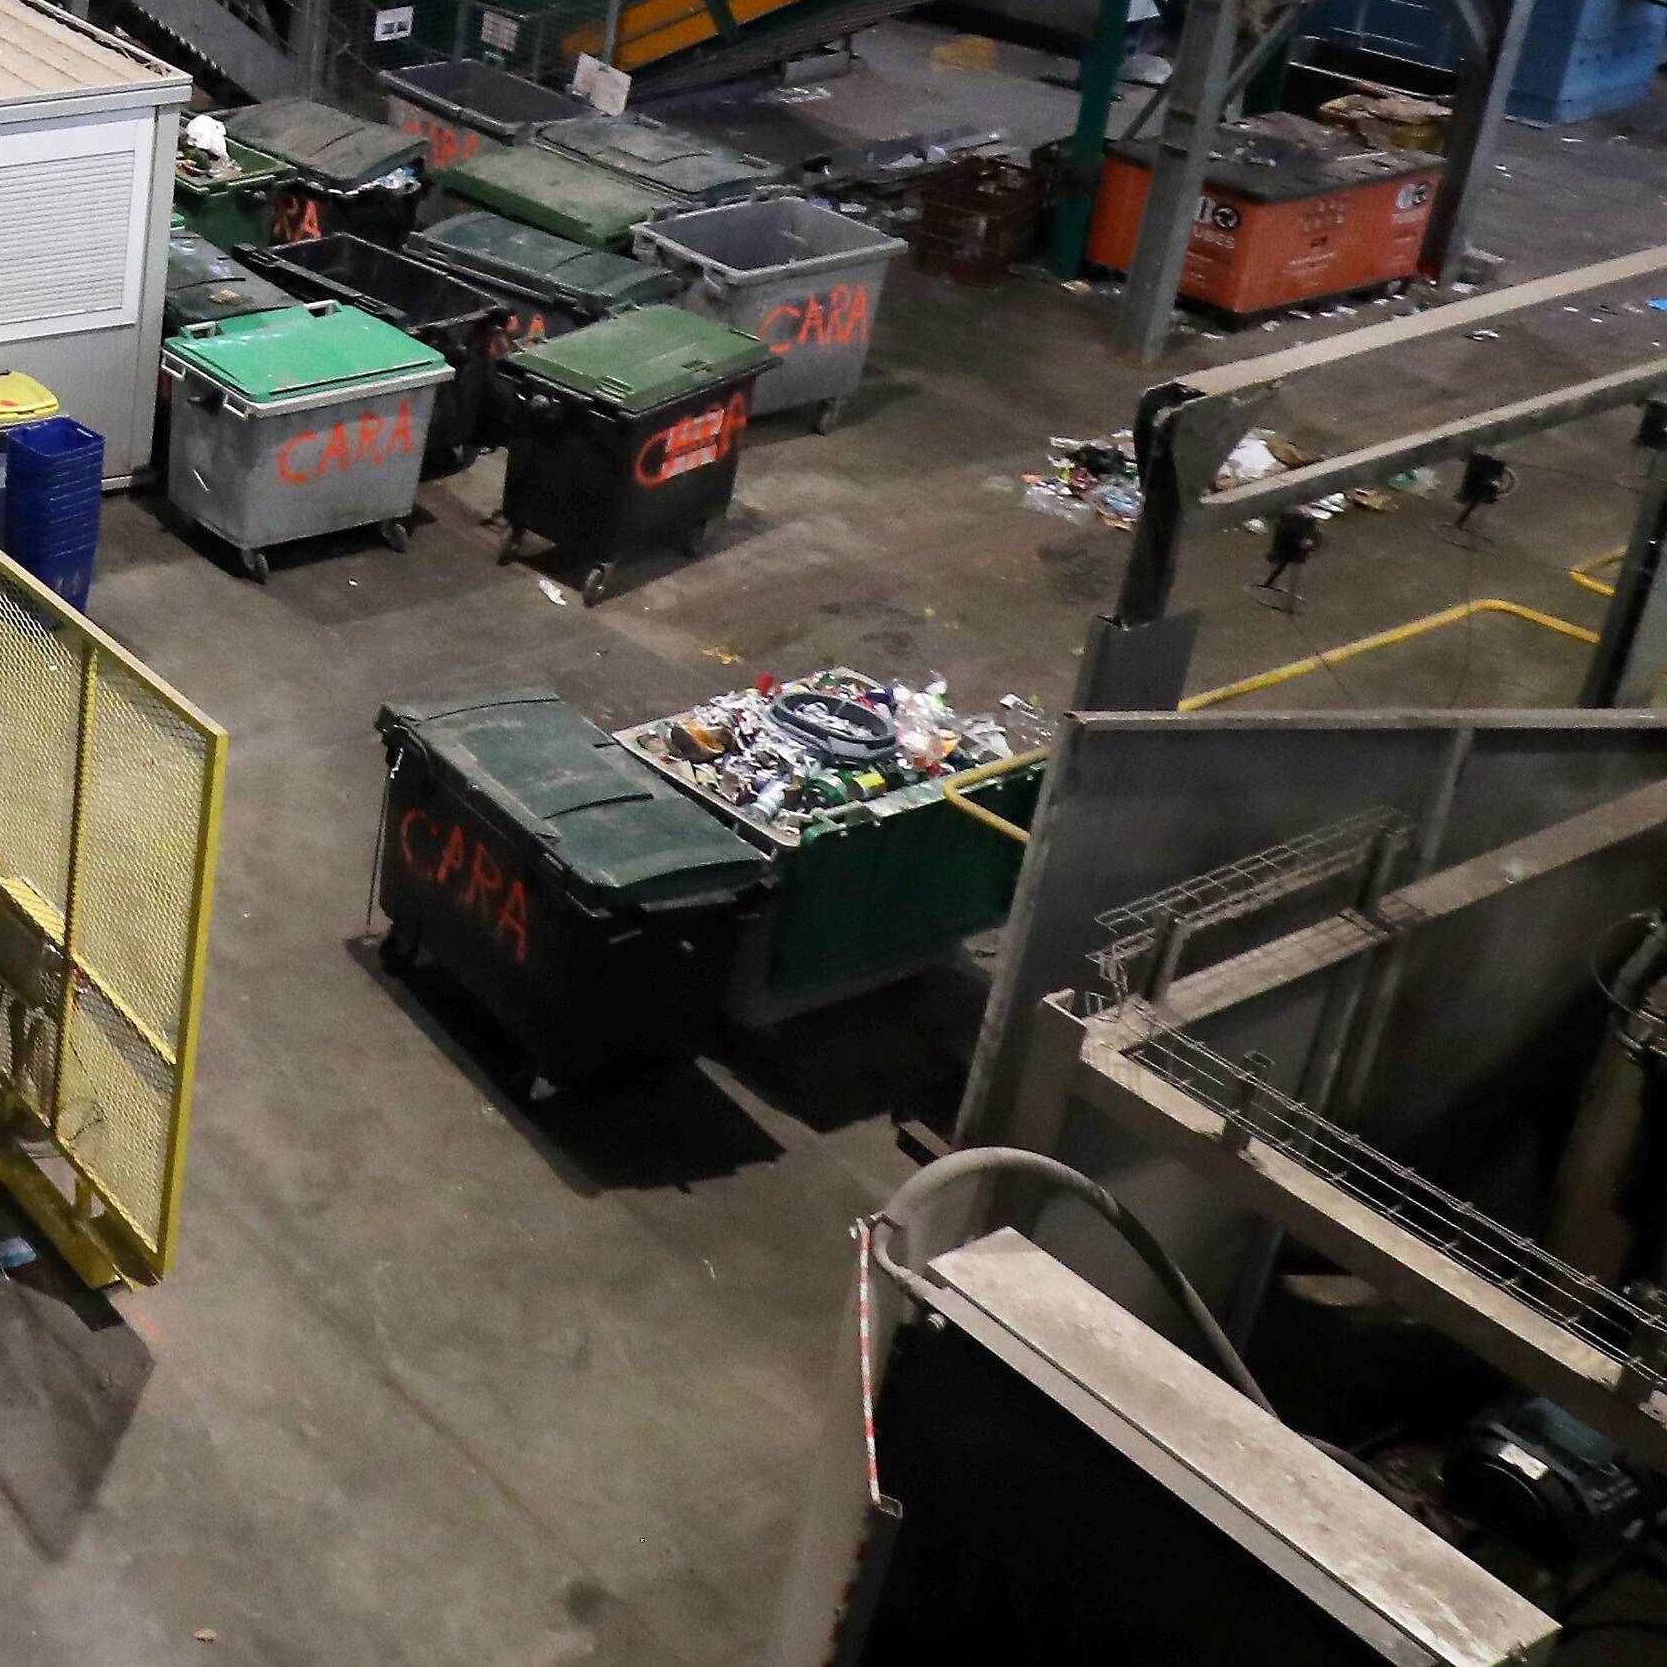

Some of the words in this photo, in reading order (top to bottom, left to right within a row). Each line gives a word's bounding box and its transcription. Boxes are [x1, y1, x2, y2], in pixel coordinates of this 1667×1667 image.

[757, 282, 870, 356] CARA
[277, 397, 413, 485] CARA
[399, 807, 527, 963] CARA
